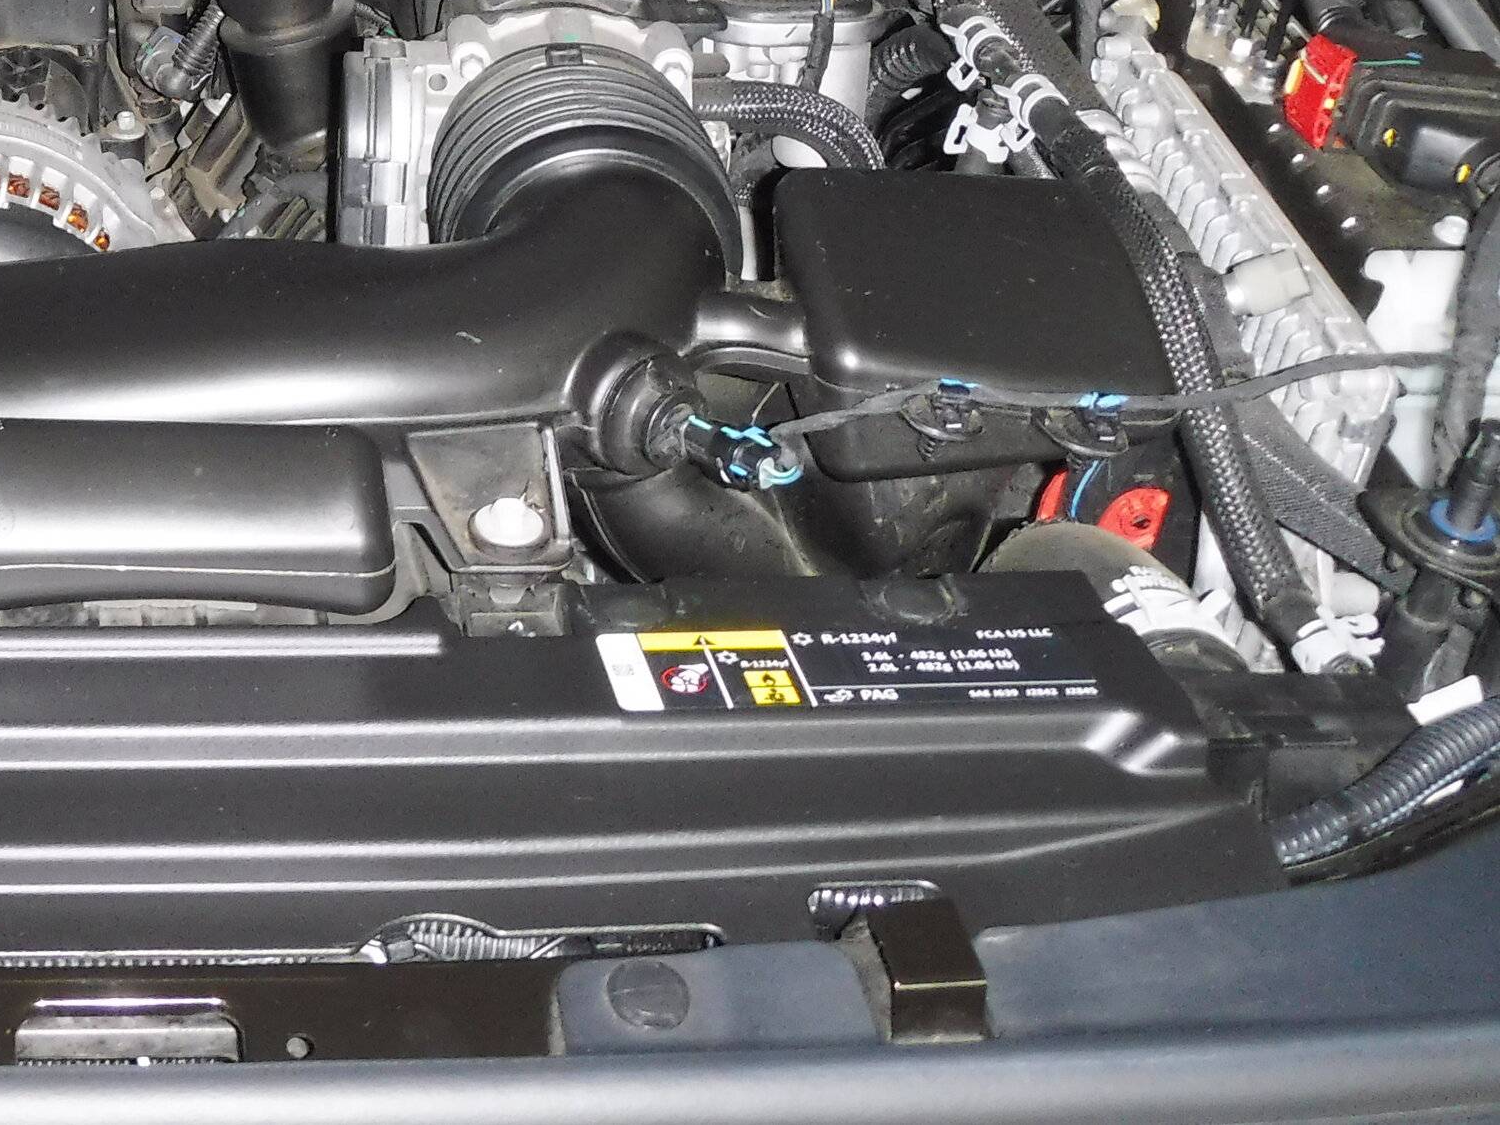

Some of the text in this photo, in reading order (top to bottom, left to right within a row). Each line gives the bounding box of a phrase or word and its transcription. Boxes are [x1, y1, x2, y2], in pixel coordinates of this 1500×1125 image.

[820, 631, 898, 646] R-1234yf
[975, 627, 1054, 640] FCA US LLC
[860, 688, 899, 701] PAG
